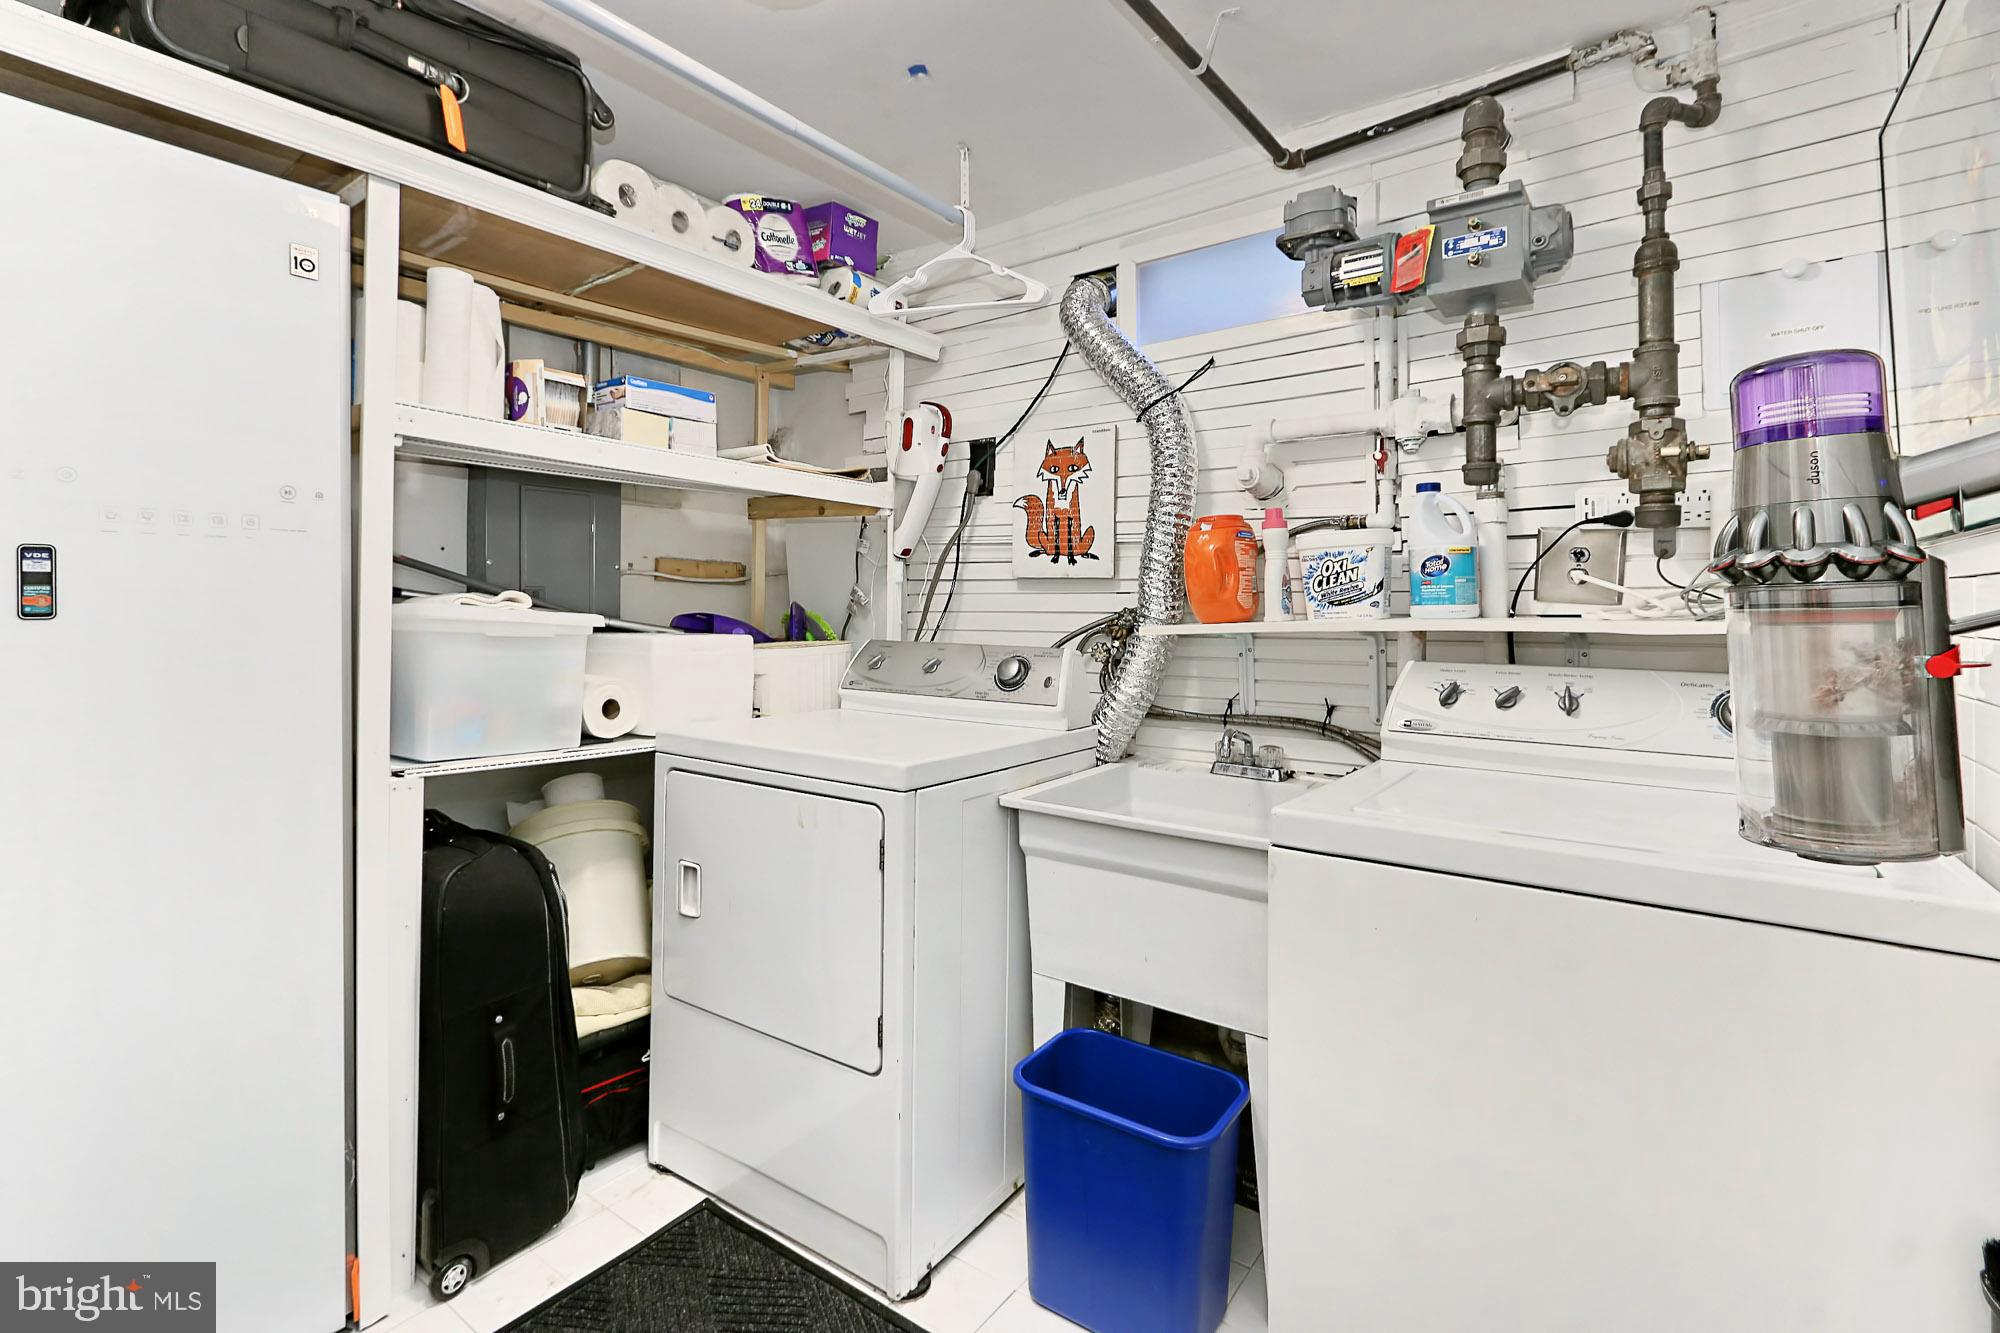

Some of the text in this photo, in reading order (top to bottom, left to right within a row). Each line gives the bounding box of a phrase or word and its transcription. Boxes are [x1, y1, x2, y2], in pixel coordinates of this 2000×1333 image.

[761, 232, 795, 245] Cottonelle
[1806, 450, 1821, 485] dyson
[1321, 557, 1349, 577] OXI
[1424, 563, 1448, 574] Home
[1313, 566, 1360, 593] CLEAN
[1321, 587, 1339, 599] White
